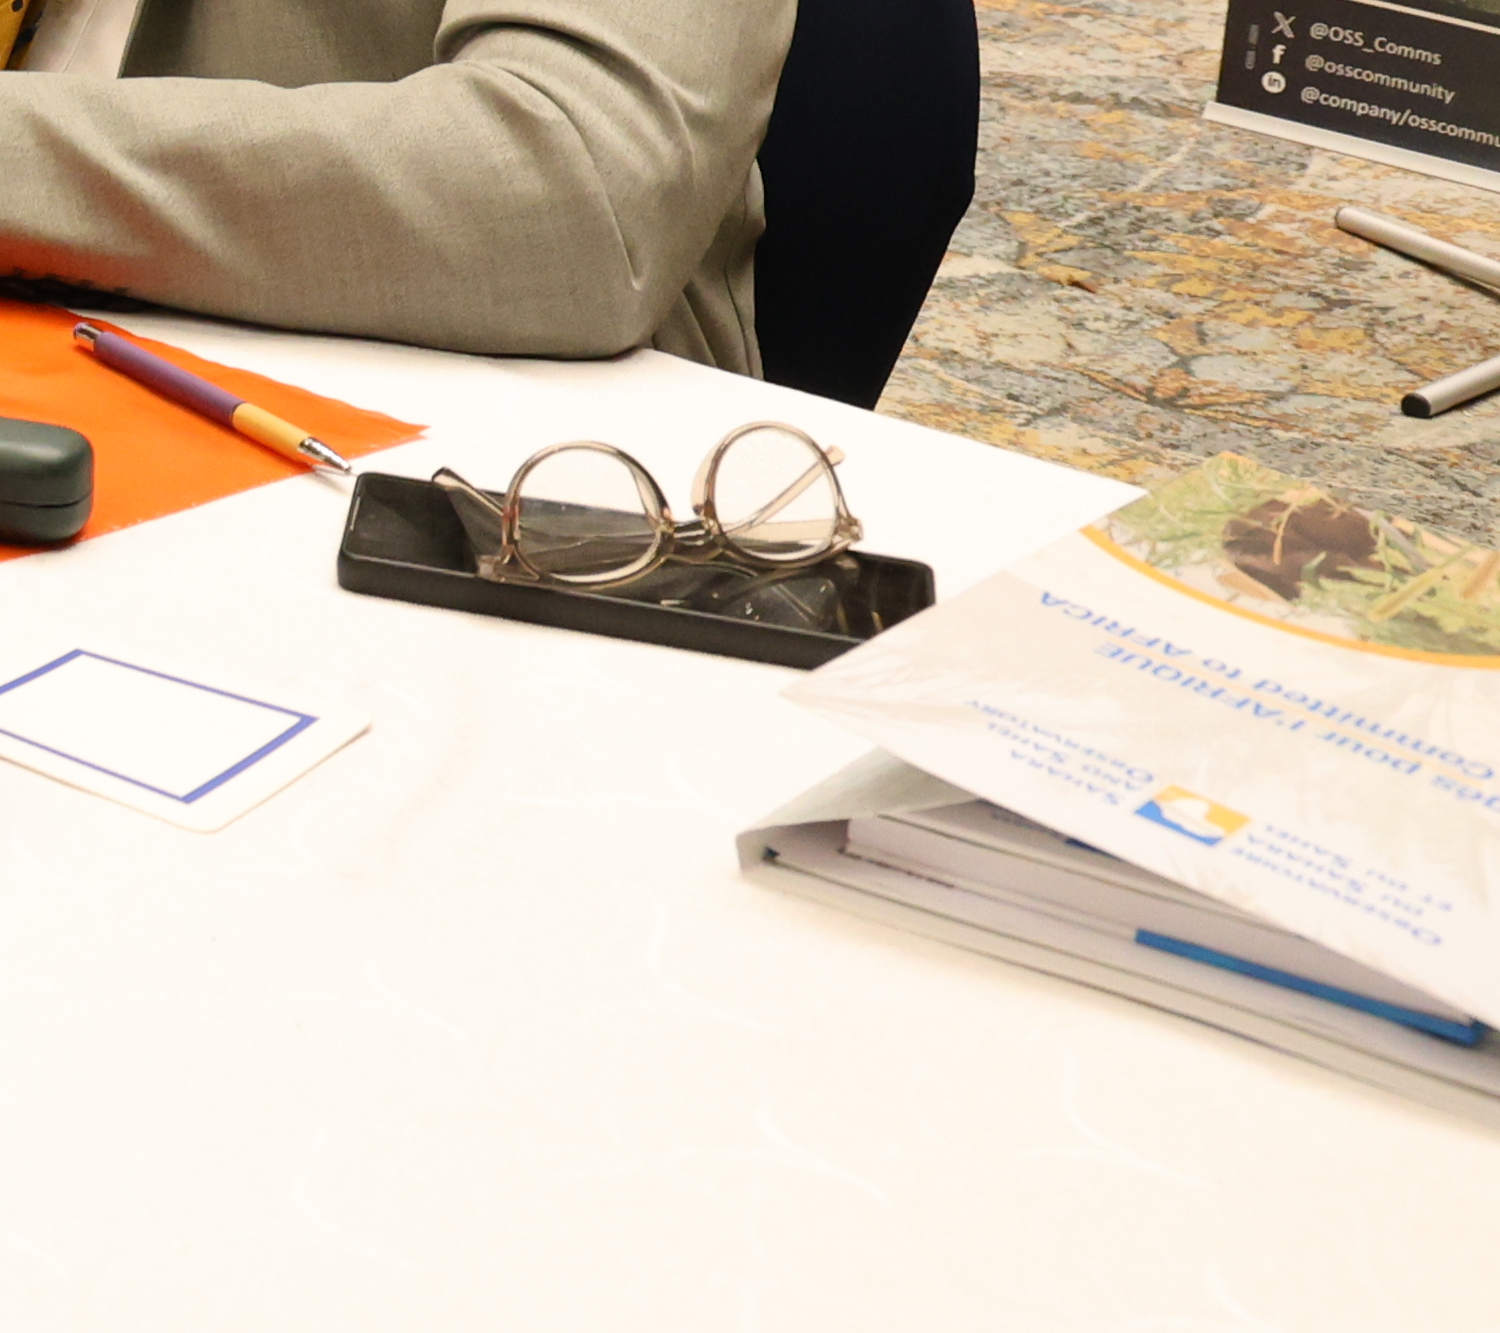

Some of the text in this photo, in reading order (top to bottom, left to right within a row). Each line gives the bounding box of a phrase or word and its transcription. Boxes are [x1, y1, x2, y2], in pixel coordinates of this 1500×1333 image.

[1310, 22, 1442, 66] @OSS_Comms
[1305, 54, 1456, 104] @osscommunity
[1038, 590, 1495, 780] Committed to AFRICA
[1315, 729, 1422, 777] pour
